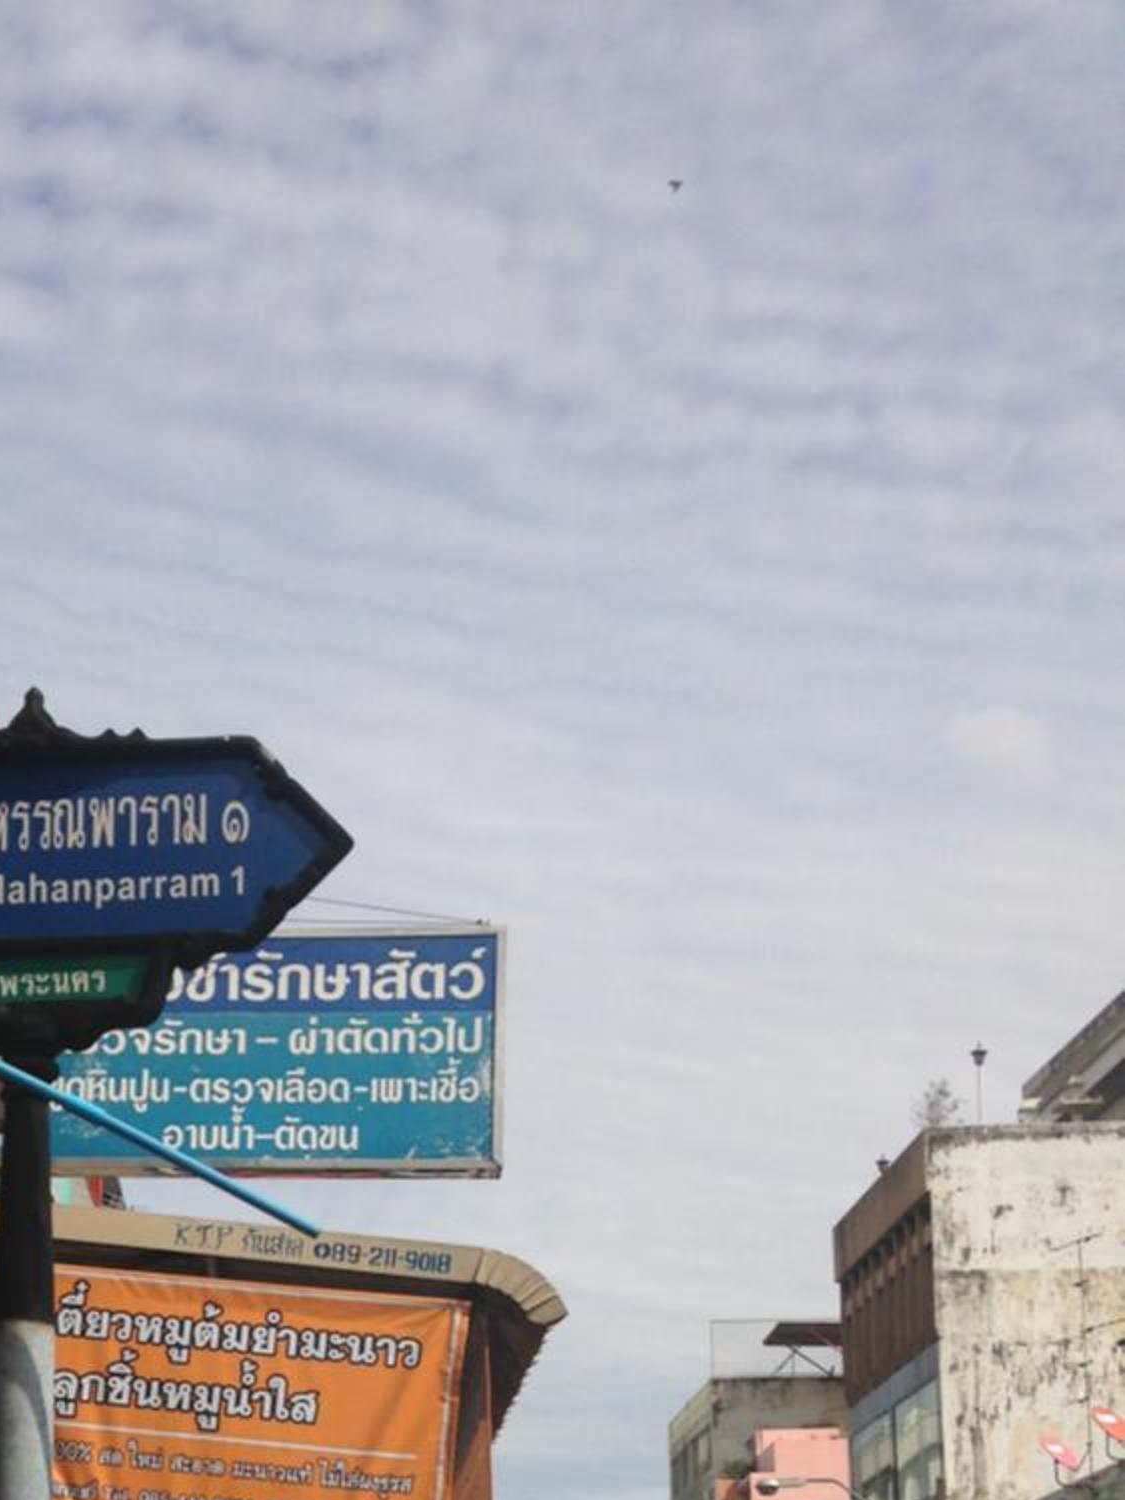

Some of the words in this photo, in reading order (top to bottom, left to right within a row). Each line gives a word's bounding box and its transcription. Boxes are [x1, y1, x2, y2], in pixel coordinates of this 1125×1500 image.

[230, 866, 247, 896] 1
[65, 1018, 247, 1056] วจรักษา
[289, 1011, 485, 1056] ผ่าตัดทั่วไป
